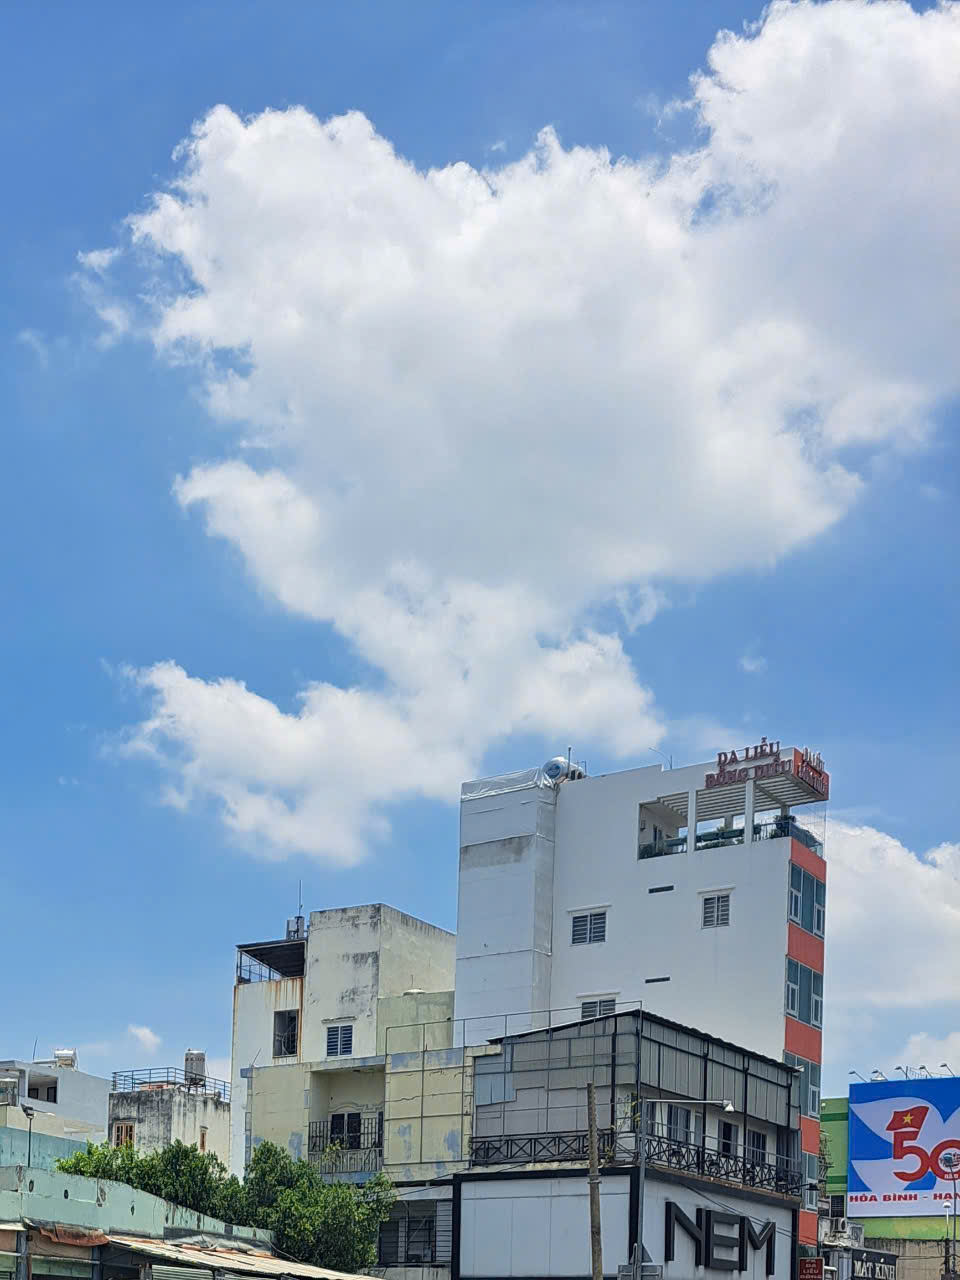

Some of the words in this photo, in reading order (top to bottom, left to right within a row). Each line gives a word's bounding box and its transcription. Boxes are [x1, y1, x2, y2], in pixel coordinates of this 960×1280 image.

[717, 750, 740, 766] DA
[664, 1201, 776, 1276] NEM
[875, 1258, 896, 1280] KÍNH
